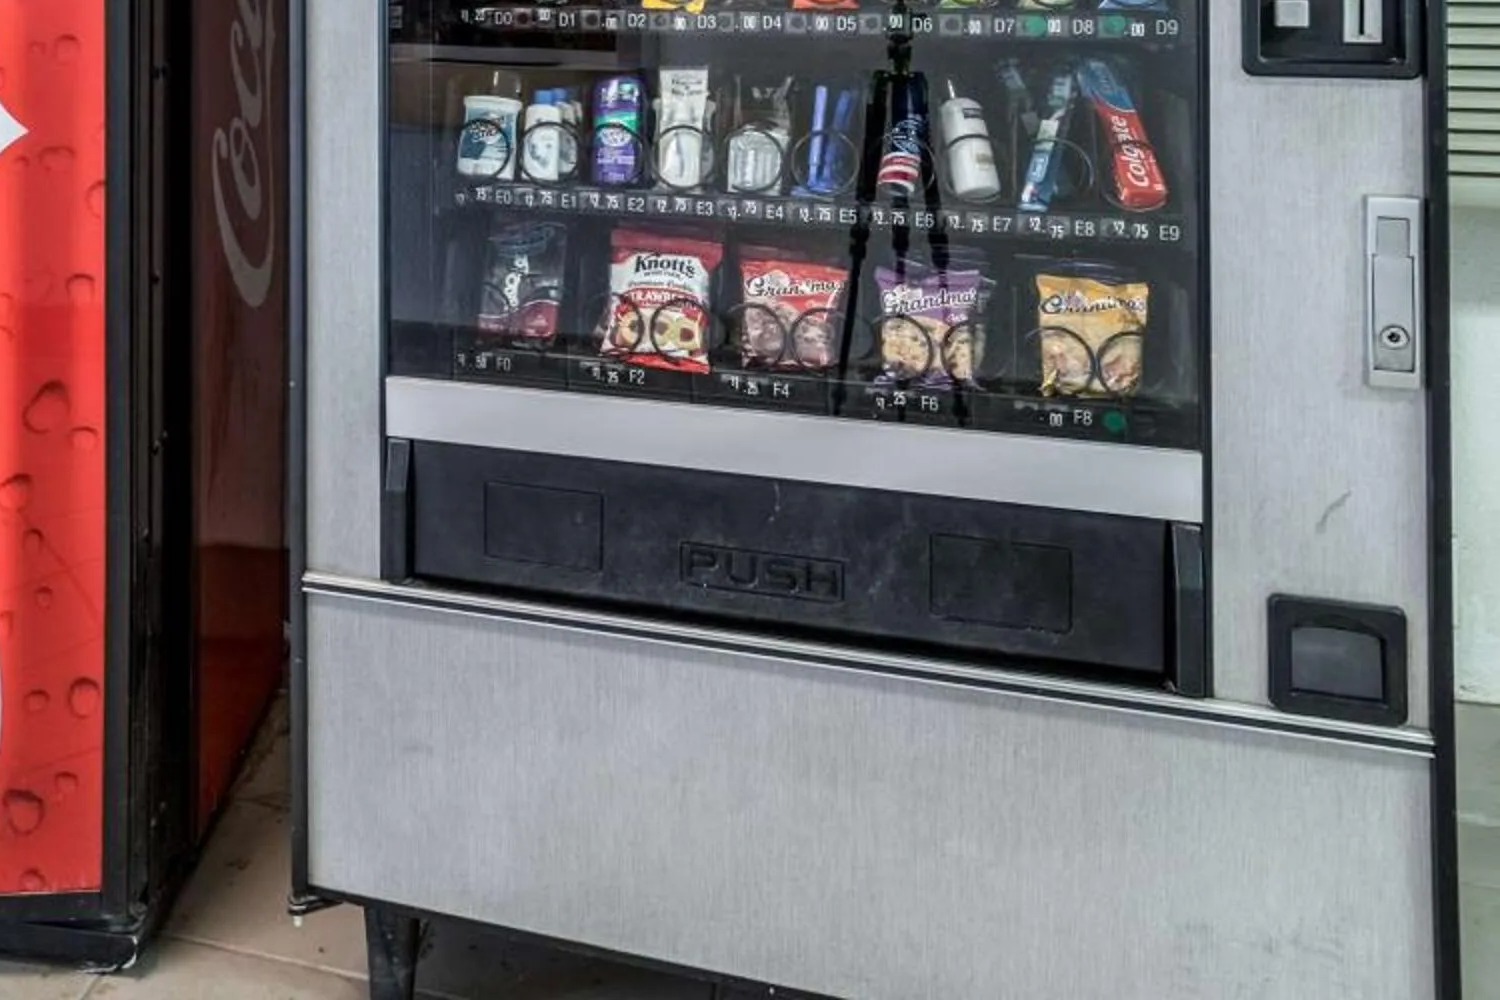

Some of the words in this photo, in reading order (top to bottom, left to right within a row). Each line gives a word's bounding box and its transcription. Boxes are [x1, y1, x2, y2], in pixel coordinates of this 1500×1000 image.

[628, 13, 645, 28] D2
[697, 14, 716, 29] D3
[763, 15, 782, 30] D4
[836, 15, 857, 31] D5
[912, 18, 933, 32] D6
[994, 18, 1014, 33] D7
[1073, 19, 1093, 34] D8
[1155, 19, 1178, 35] D9
[1110, 115, 1150, 188] Colgate
[628, 197, 645, 212] E2
[697, 201, 714, 216] E3
[765, 204, 783, 220] E4
[839, 208, 857, 223] E5
[915, 211, 935, 228] E6
[993, 215, 1011, 232] E7
[1075, 220, 1095, 236] E8
[1160, 225, 1180, 241] E9
[634, 254, 695, 279] Knott's
[629, 368, 645, 385] F2
[773, 382, 790, 398] F4
[921, 395, 939, 412] F6
[1073, 409, 1093, 426] F8
[687, 550, 838, 598] PUSH
